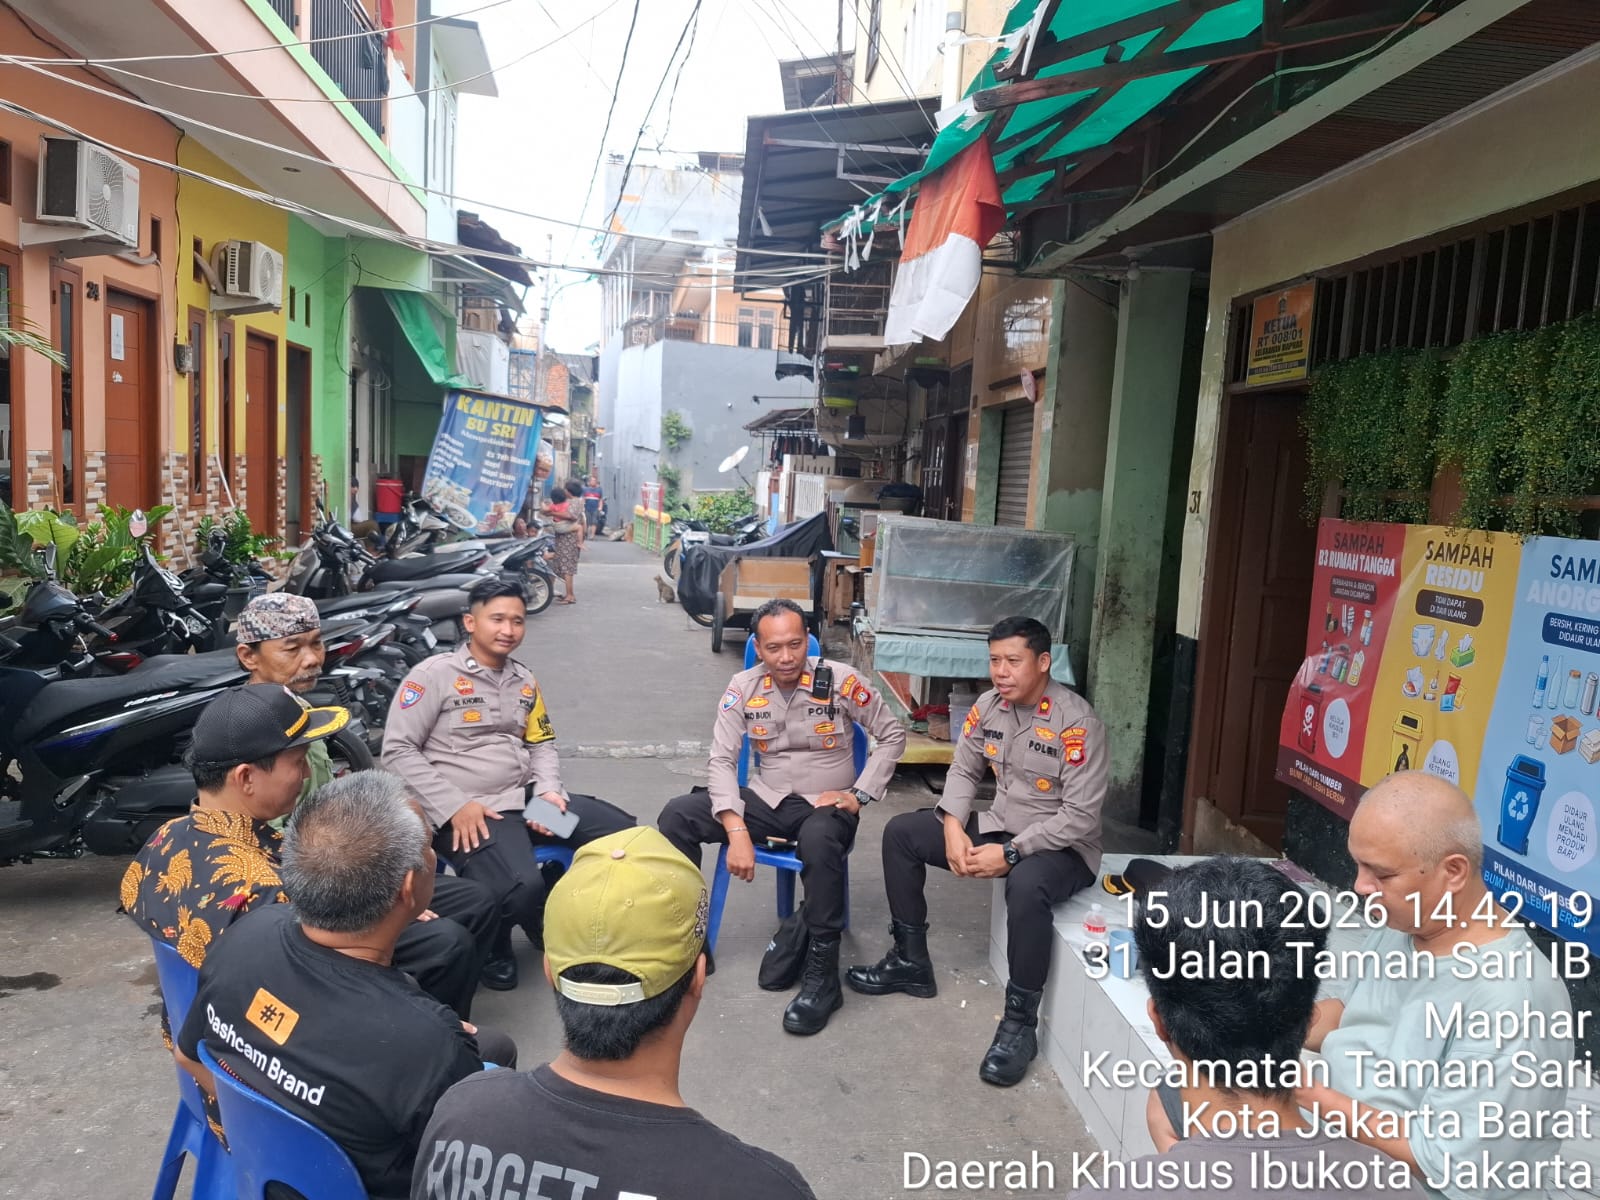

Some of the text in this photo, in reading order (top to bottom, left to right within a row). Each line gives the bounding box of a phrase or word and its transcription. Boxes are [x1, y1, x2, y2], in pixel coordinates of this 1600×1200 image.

[86, 281, 100, 301] 24
[1257, 335, 1269, 348] RT
[456, 394, 535, 426] KANTIN
[465, 417, 517, 439] BU SRI
[1189, 490, 1201, 514] 31
[1334, 532, 1385, 554] SAMPAH
[1318, 549, 1396, 577] B3 RUMAH TANGGA
[1425, 540, 1494, 568] SAMPAH
[1425, 564, 1485, 593] RESIDU
[1549, 617, 1600, 635] BERSIH, KERING
[1559, 630, 1585, 645] DIDAUR
[755, 711, 771, 720] BUDI
[1028, 740, 1058, 757] POLRI
[1564, 804, 1587, 821] DIDAUR
[1564, 815, 1585, 831] ULANG
[1557, 833, 1586, 853] PRODUK
[1558, 824, 1588, 843] MENJADI
[1557, 845, 1577, 860] BARU
[1494, 861, 1515, 882] PILAH
[1516, 873, 1537, 893] DARI
[1484, 870, 1504, 889] BUMI
[1525, 892, 1551, 914] LEBIH
[259, 1003, 286, 1032] #1
[206, 1003, 326, 1106] Dashcam Brand
